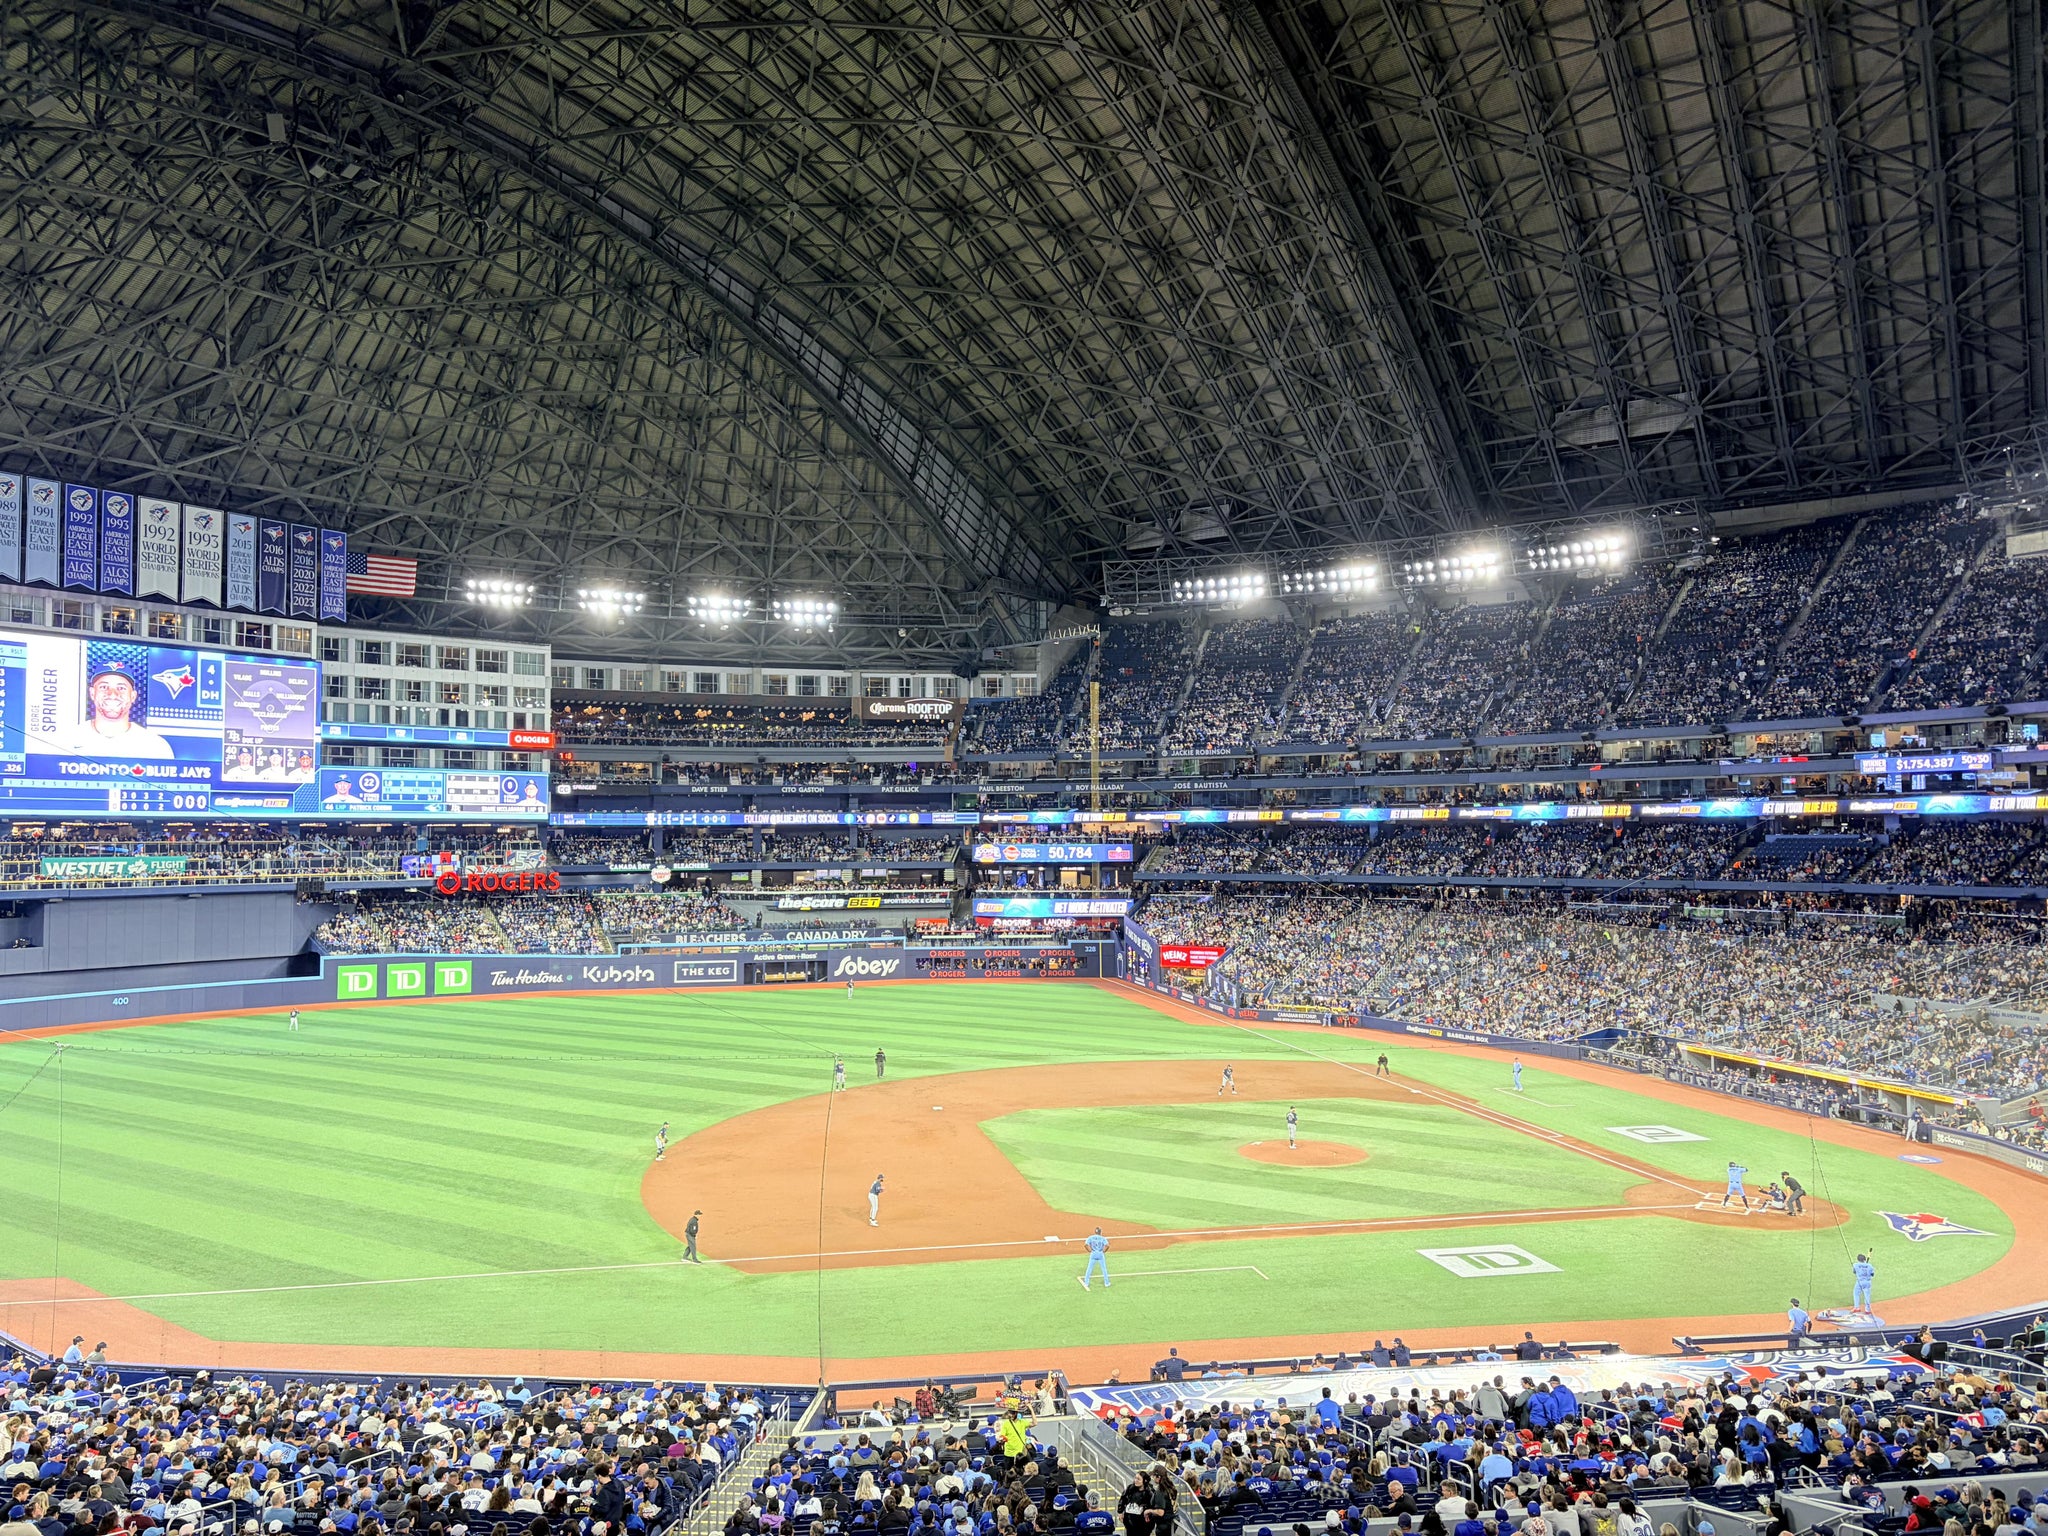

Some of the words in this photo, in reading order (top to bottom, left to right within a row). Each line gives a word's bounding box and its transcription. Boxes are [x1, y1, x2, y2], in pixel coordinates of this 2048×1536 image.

[33, 505, 54, 518] 1991
[69, 511, 93, 524] 1992
[30, 519, 56, 528] AMERICAN
[69, 524, 94, 533] AMERICAN
[106, 517, 129, 530] 1993
[29, 526, 56, 536] LEAGUE
[68, 531, 94, 541] LEAGUE
[105, 530, 130, 539] AMERICAN
[143, 523, 176, 542] 1992
[29, 533, 55, 546] EAST
[67, 539, 93, 551] EAST
[104, 537, 130, 547] LEAGUE
[188, 531, 219, 549] 1993
[232, 538, 252, 550] 2015
[29, 543, 56, 553] CHAMPS
[67, 548, 94, 559] CHAMPS
[104, 545, 129, 557] EAST
[142, 541, 177, 555] WORLD
[187, 547, 220, 561] WORLD
[263, 543, 284, 555] 2016
[103, 554, 129, 563] CHAMPS
[141, 552, 177, 566] SERIES
[230, 556, 252, 565] LEAGUE
[263, 556, 285, 567] ALDS
[294, 554, 314, 566] 2016
[324, 553, 345, 564] 2025
[67, 561, 93, 573] ALCS
[141, 562, 177, 573] CHAMPIONS
[186, 558, 220, 572] SERIES
[230, 563, 251, 575] EAST
[262, 565, 285, 574] CHAMPS
[66, 572, 93, 581] CHAMPS
[103, 566, 129, 578] ALCS
[186, 568, 220, 579] CHAMPIONS
[293, 568, 315, 580] 2020
[324, 570, 344, 579] LEAGUE
[103, 576, 129, 586] CHAMPS
[324, 577, 344, 587] EAST
[230, 584, 252, 595] ALDS
[293, 582, 315, 593] 2022
[323, 585, 344, 594] CHAMPS
[293, 596, 315, 608] 2023
[324, 596, 344, 607] ALCS
[323, 605, 344, 614] CHAMPS
[207, 665, 215, 675] 4
[42, 668, 58, 733] SPRINGER
[202, 691, 220, 700] DH
[870, 702, 906, 716] Corona
[907, 702, 954, 715] ROOFTOP
[30, 704, 40, 732] GEORGE
[522, 734, 550, 744] ROGERS
[1171, 749, 1194, 757] JACKIE
[1195, 748, 1231, 756] ROBINSON
[59, 762, 130, 777] TORONTO
[146, 765, 178, 778] BLUE
[179, 766, 212, 779] JAYS
[363, 778, 375, 787] 22
[1173, 780, 1191, 790] JOSÉ
[1193, 781, 1228, 789] BAUTISTA
[1762, 803, 1774, 814] BET
[1774, 803, 1783, 814] ON
[1783, 802, 1804, 814] YOUR
[1804, 802, 1821, 813] BLUE
[1821, 802, 1838, 813] JAYS
[1894, 801, 1918, 810] BET
[1990, 798, 2004, 810] BET
[2004, 798, 2016, 810] ON
[2016, 798, 2037, 810] YOUR
[1567, 806, 1578, 817] BET
[1578, 806, 1586, 817] ON
[1586, 806, 1603, 817] YOUR
[1603, 806, 1617, 817] BLUE
[1617, 805, 1631, 816] JAYS
[743, 814, 770, 824] FOLLOW
[770, 814, 807, 824] @BLUEJAYS
[808, 814, 817, 823] ON
[818, 814, 839, 823] SOCIAL
[1048, 846, 1093, 861] 50,784
[45, 861, 128, 876] WESTJET
[150, 861, 185, 869] FLIGHT
[468, 871, 561, 892] ROGERS
[778, 897, 845, 909] theScore
[849, 899, 880, 907] BET
[1054, 902, 1067, 913] BET
[1090, 902, 1128, 913] ACTIVATED
[1002, 919, 1032, 927] ROGERS
[675, 933, 747, 944] BLEACHERS
[786, 931, 841, 941] CANADA
[842, 930, 868, 939] DRY
[777, 953, 818, 961] Green+Ross
[1162, 950, 1188, 961] HEINZ
[682, 967, 704, 977] THE
[708, 967, 730, 976] KEG
[834, 955, 900, 977] Sobeys
[391, 969, 421, 990] TD
[439, 967, 468, 988] TD
[490, 970, 514, 986] Tim
[582, 965, 655, 983] Kubota
[343, 971, 373, 992] TD
[112, 996, 129, 1006] 400
[1239, 1010, 1259, 1019] HEINZ
[1446, 1031, 1476, 1041] BASELINE
[1475, 1036, 1489, 1044] BOX
[1945, 1136, 1965, 1146] clover
[1435, 1250, 1534, 1270] TD
[1600, 1461, 1616, 1473] 27
